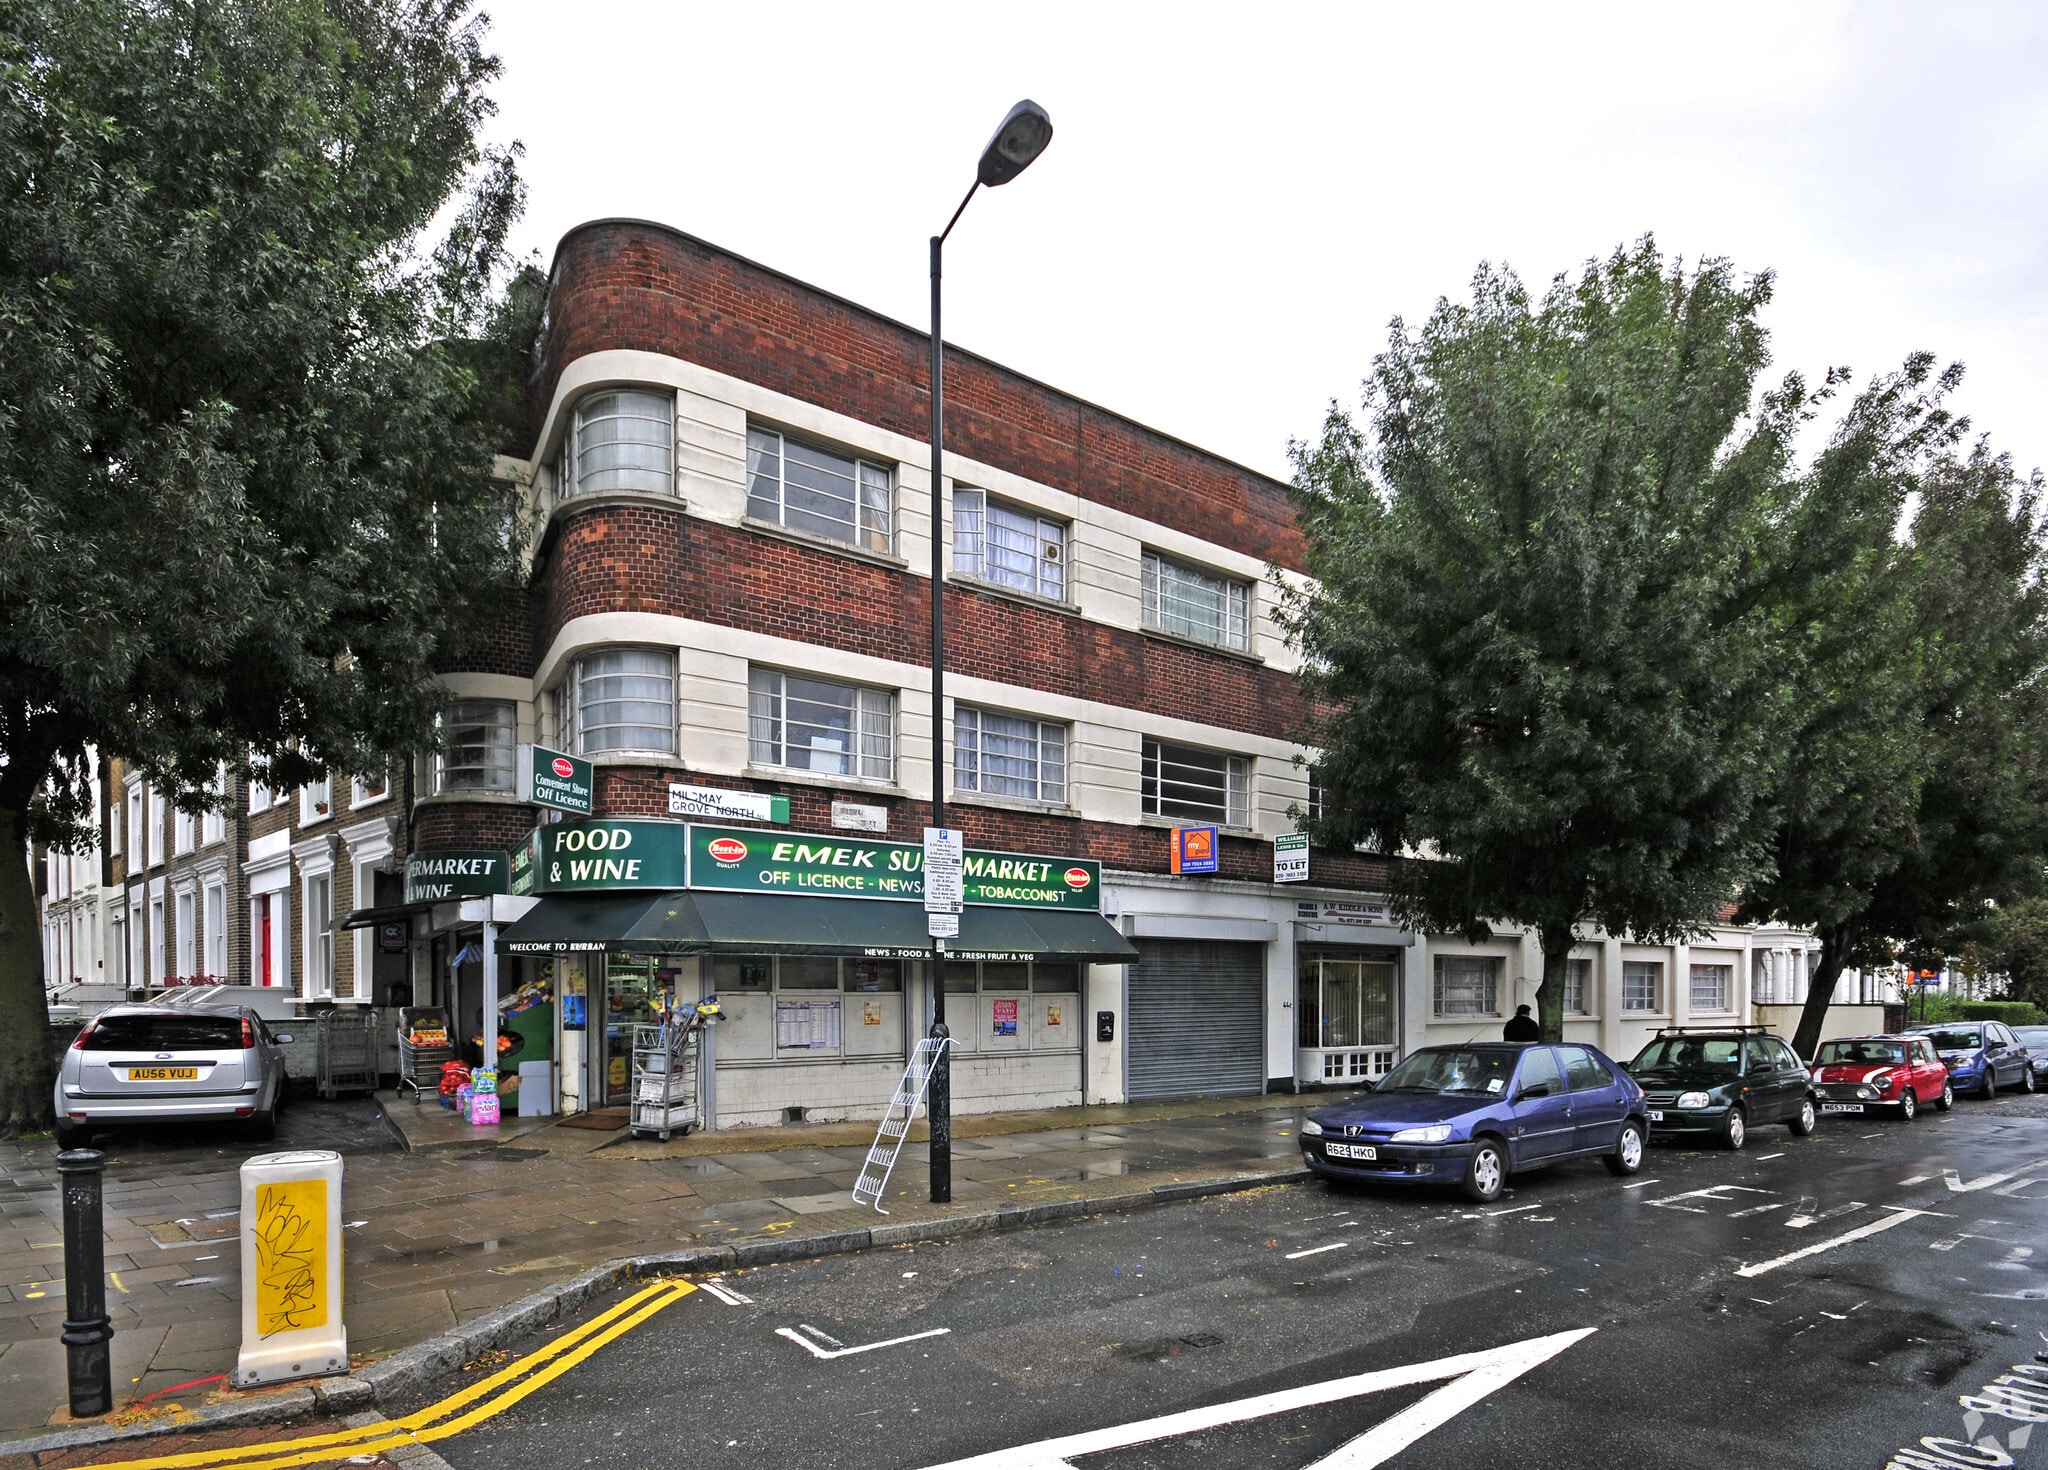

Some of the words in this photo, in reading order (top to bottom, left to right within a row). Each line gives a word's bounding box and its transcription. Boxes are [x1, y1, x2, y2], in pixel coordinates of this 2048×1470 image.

[536, 773, 571, 792] Convenient
[572, 783, 588, 796] Store
[536, 787, 553, 800] Off
[556, 792, 588, 808] Licence
[672, 802, 710, 814] GROVE
[716, 806, 754, 818] NORTH
[555, 828, 632, 852] FOOD
[712, 843, 745, 855] Best-in
[772, 843, 878, 868] EMEK
[888, 850, 1052, 882] SUMARKET
[1276, 863, 1288, 871] TO
[1290, 861, 1306, 870] LET
[550, 862, 562, 882] &
[570, 859, 642, 880] WINE
[759, 870, 790, 884] OFF
[798, 873, 864, 889] LICENCE
[879, 878, 967, 896] NEWST
[978, 885, 1066, 902] TOBACCONIST
[1368, 906, 1384, 914] SONS
[570, 942, 606, 950] KURBAN
[864, 948, 890, 956] NEWS
[898, 950, 922, 958] FOOD
[134, 1069, 166, 1078] AU56
[170, 1068, 192, 1078] VUJ
[1328, 1145, 1350, 1156] R629
[1352, 1148, 1374, 1158] HKO
